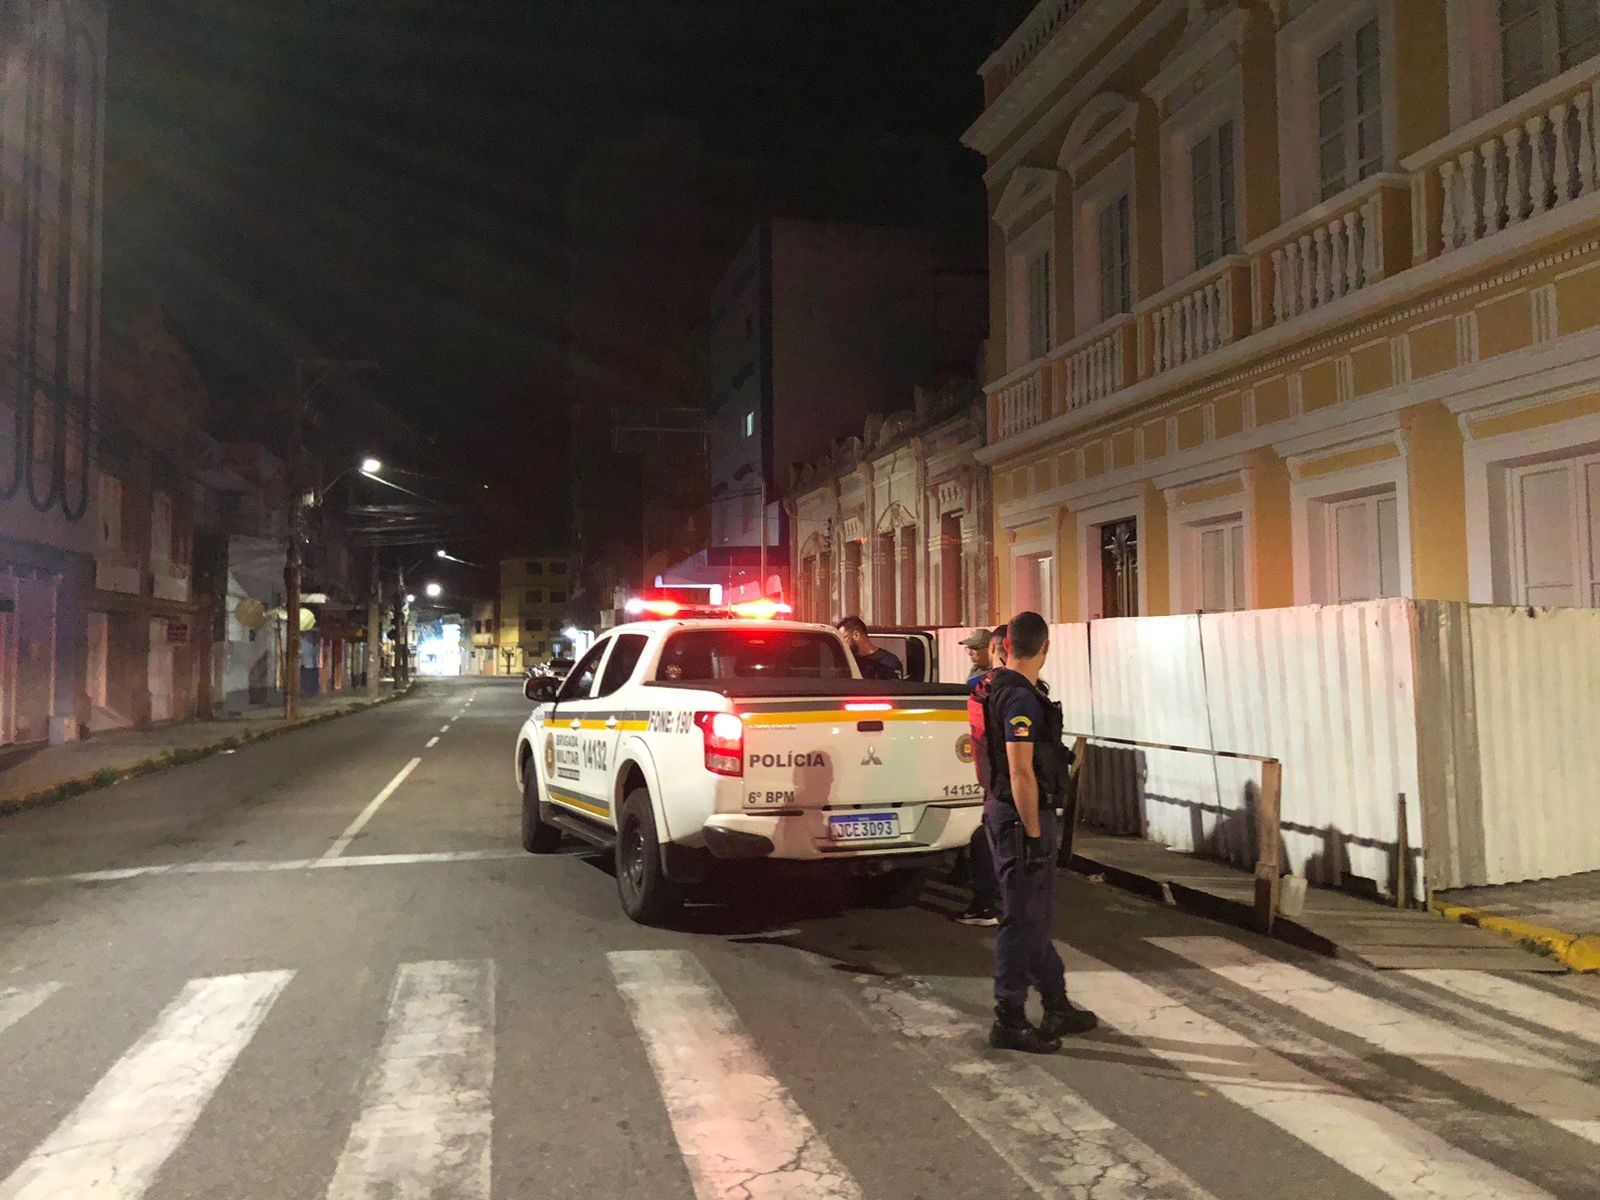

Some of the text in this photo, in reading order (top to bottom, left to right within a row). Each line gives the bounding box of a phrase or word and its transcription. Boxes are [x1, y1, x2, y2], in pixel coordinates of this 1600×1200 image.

[649, 710, 693, 734] FONE: 190
[556, 734, 578, 748] BRIGADA
[556, 749, 579, 766] MILITAR
[582, 739, 607, 771] 14132
[749, 750, 825, 768] POLÍCIA
[766, 791, 794, 803] BPM
[943, 783, 980, 796] 14132
